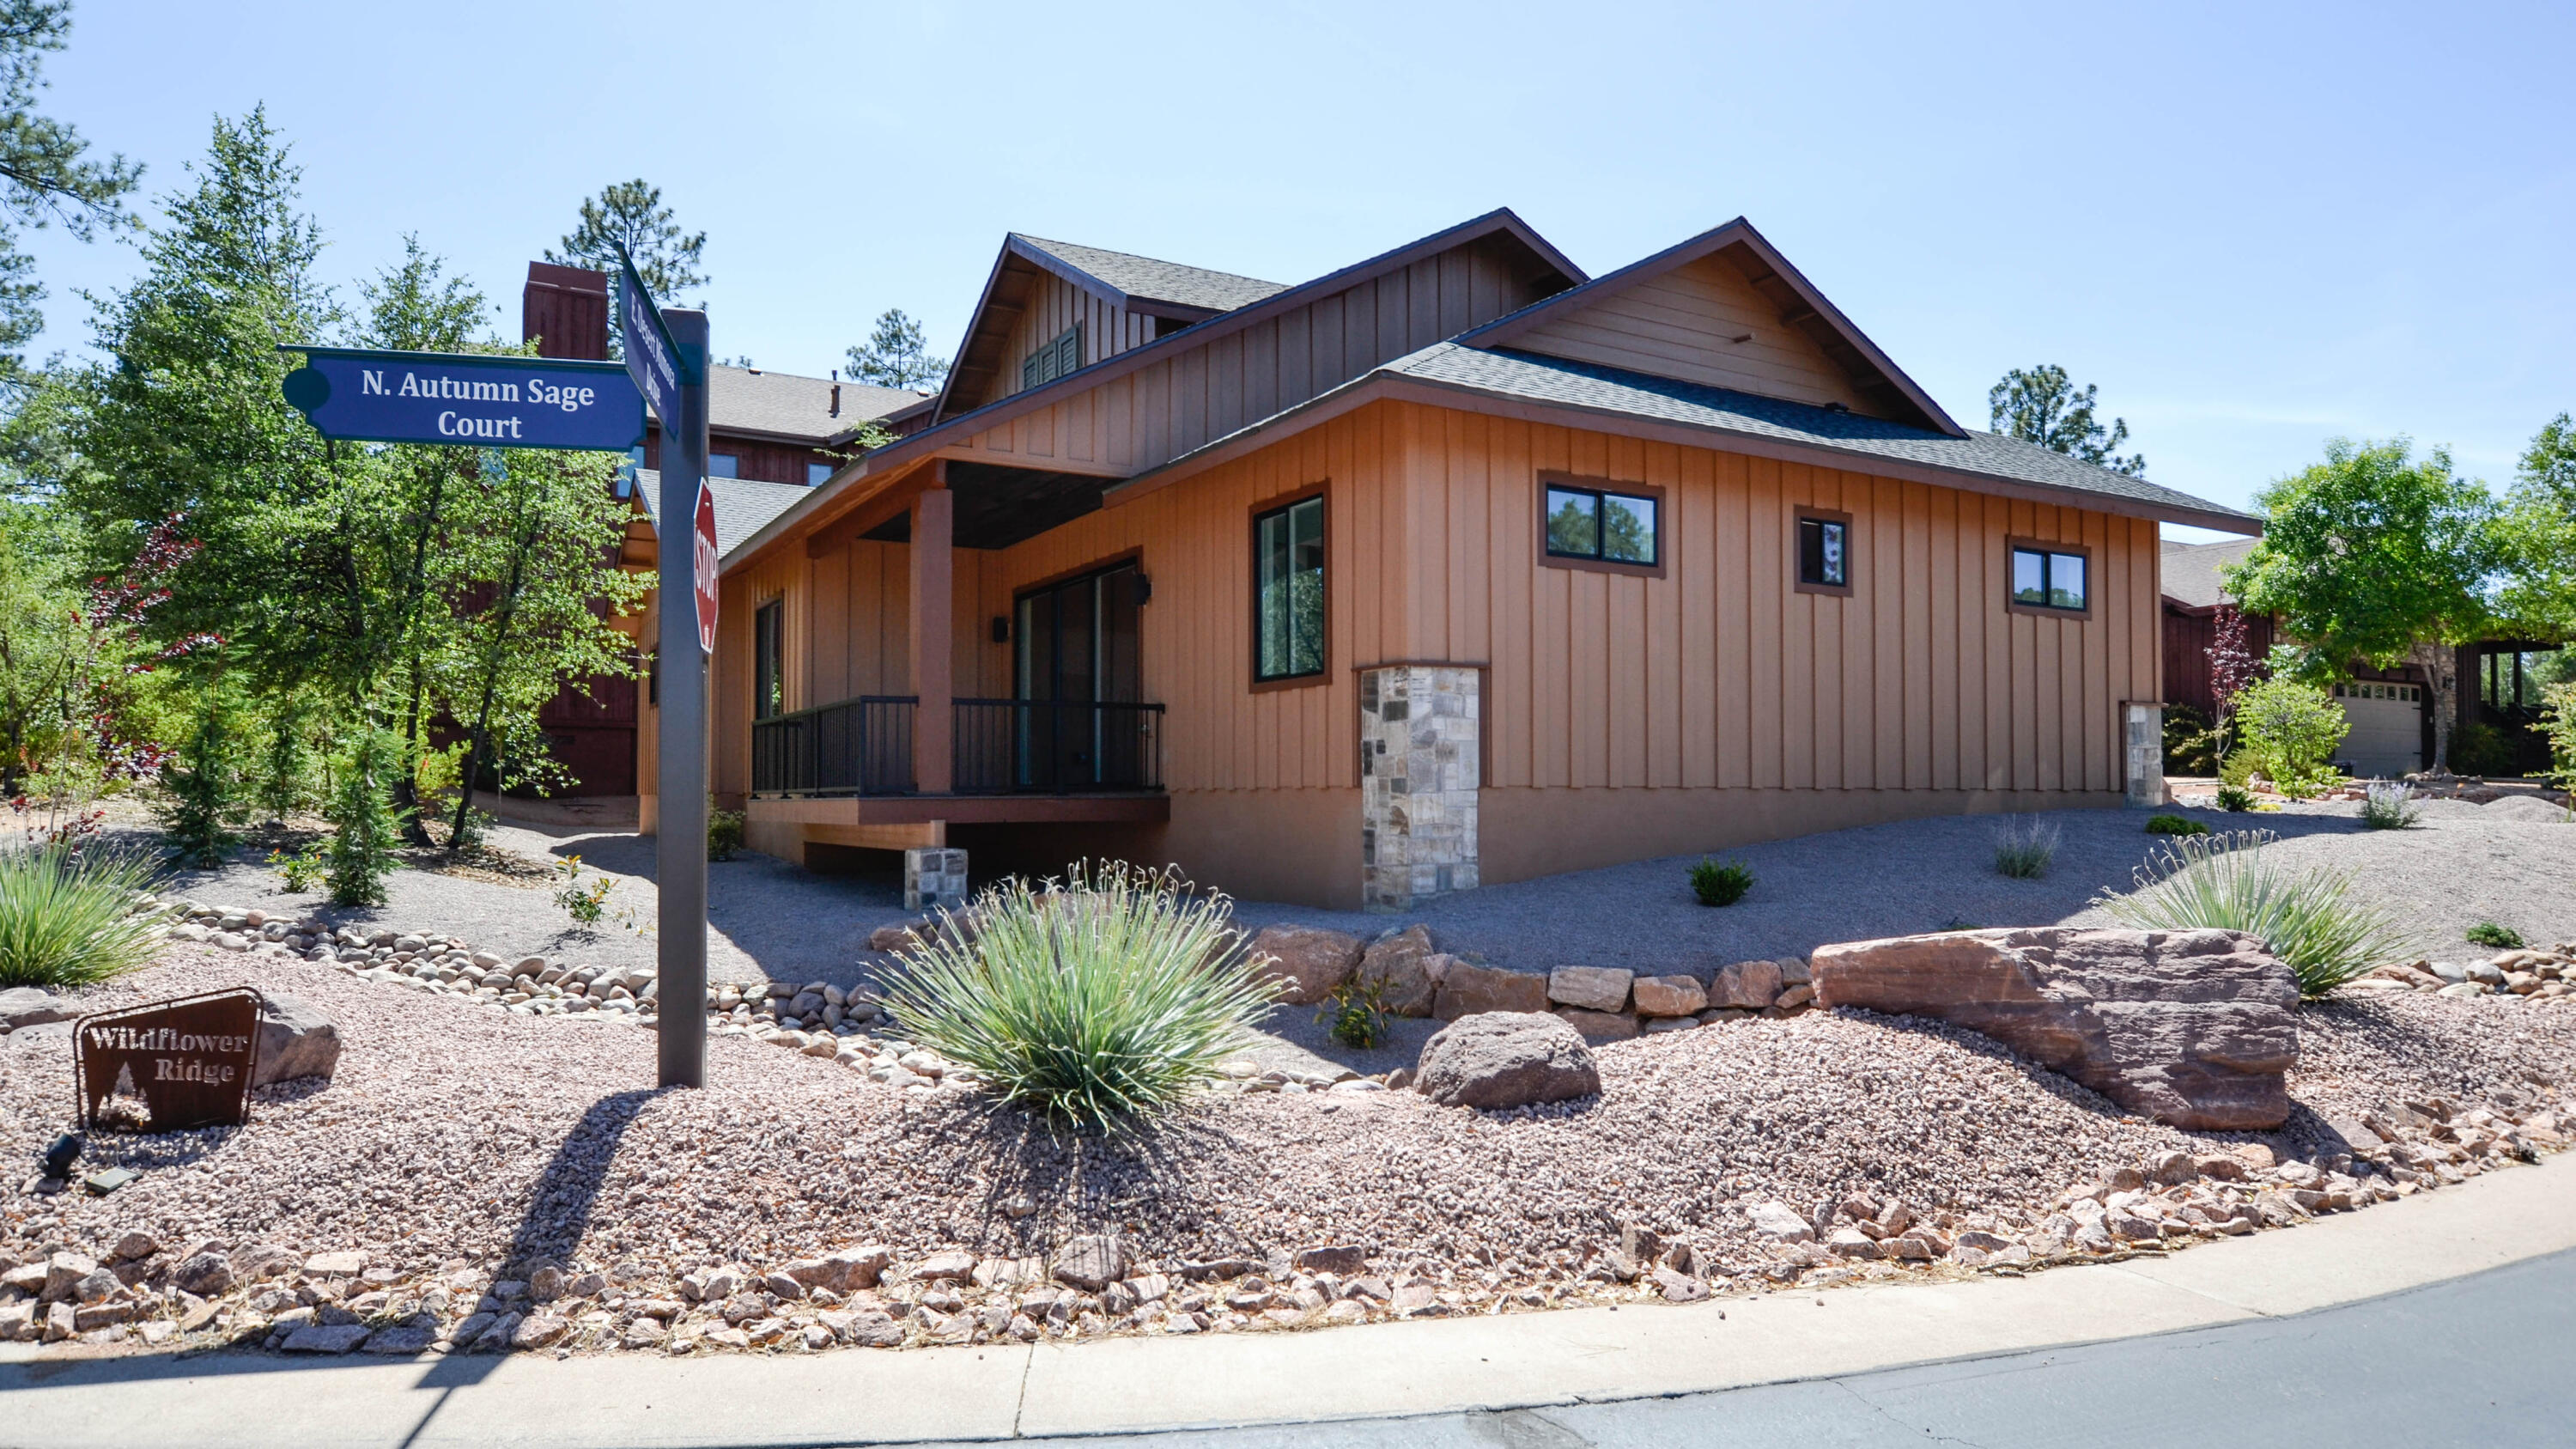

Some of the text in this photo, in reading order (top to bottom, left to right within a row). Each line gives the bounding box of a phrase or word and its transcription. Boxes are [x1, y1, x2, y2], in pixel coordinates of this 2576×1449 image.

[638, 303, 655, 358] Desert
[656, 337, 675, 391] Mimosa
[362, 370, 594, 411] N. Autumn Sage
[647, 362, 660, 406] Drive
[438, 411, 522, 438] Court
[696, 529, 716, 600] STOP
[89, 1027, 248, 1051] Wildflower
[155, 1056, 234, 1086] Ridge
